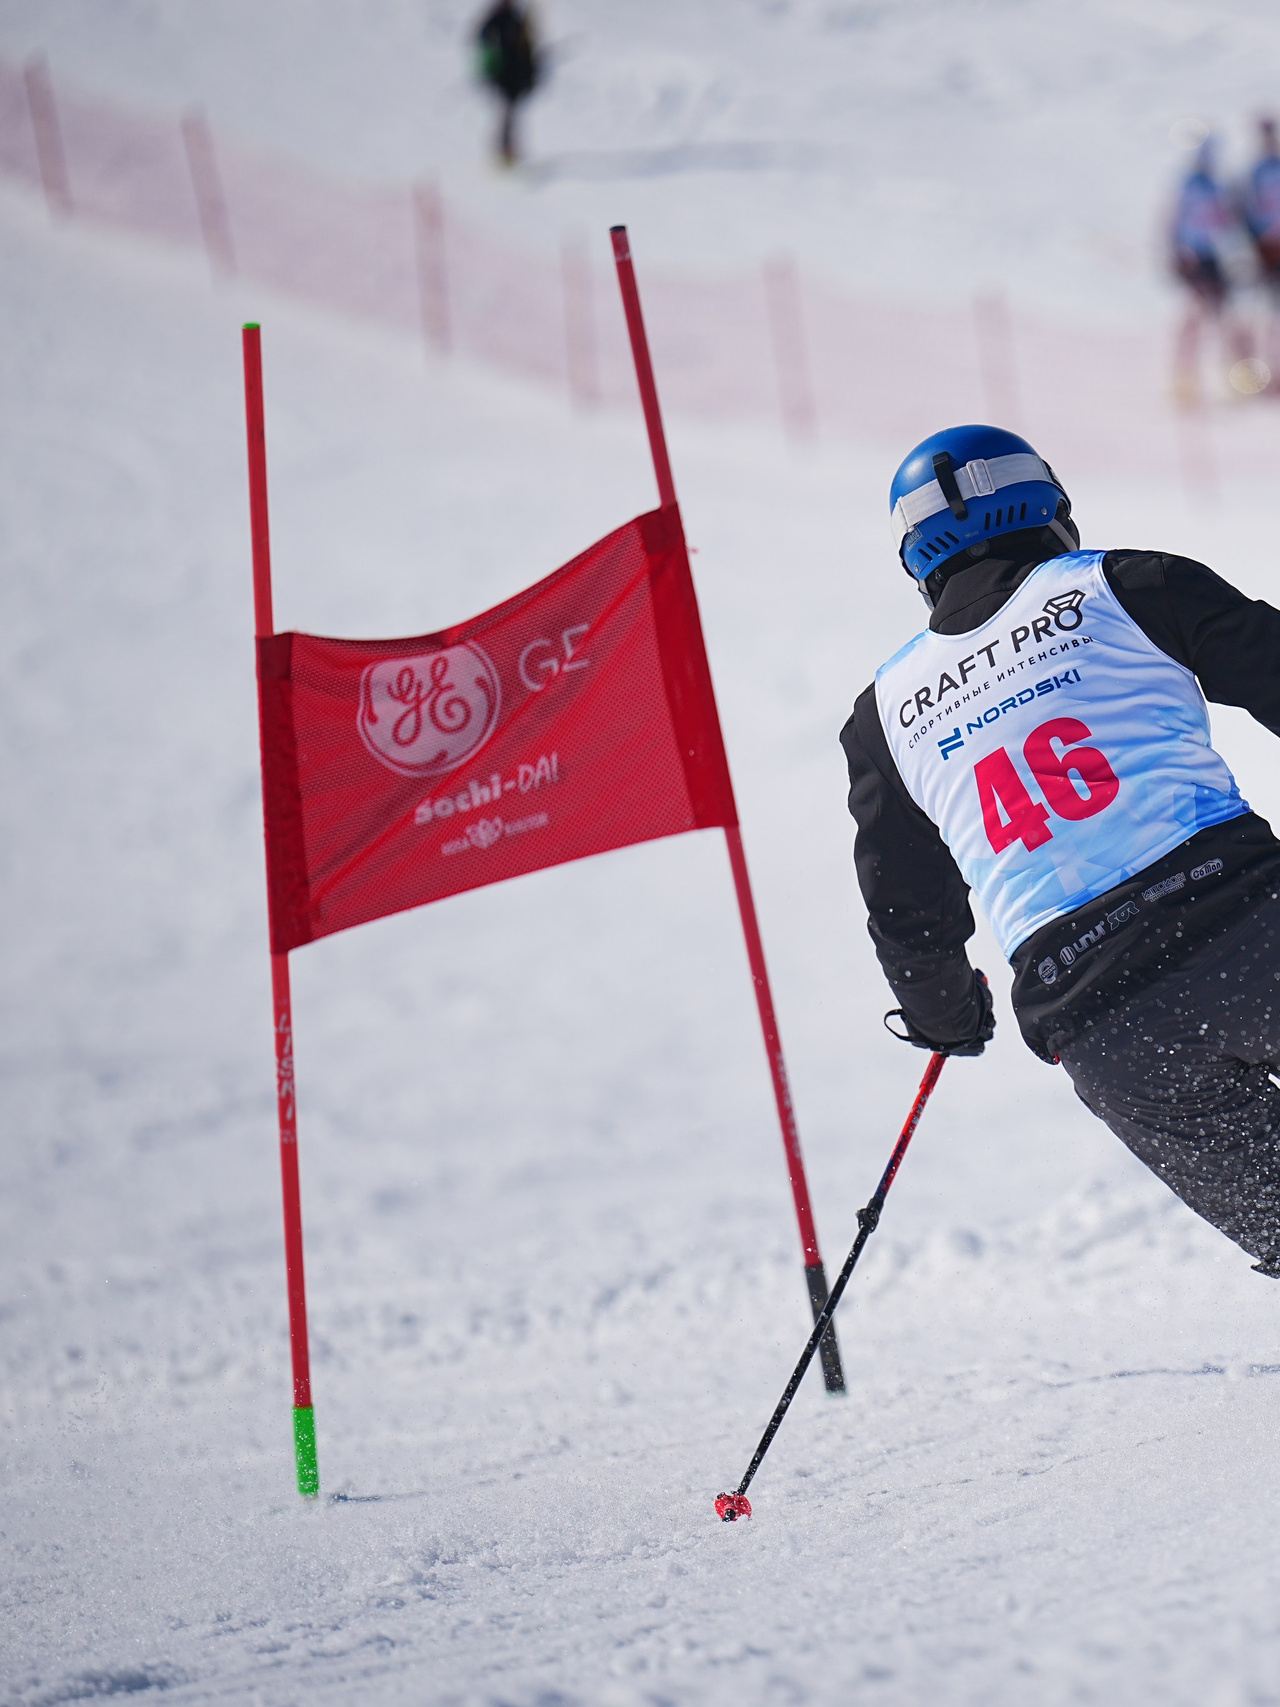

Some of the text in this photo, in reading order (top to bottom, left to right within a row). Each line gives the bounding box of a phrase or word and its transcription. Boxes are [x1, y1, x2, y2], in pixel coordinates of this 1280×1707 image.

[900, 600, 1084, 728] CRAFT PRO
[908, 636, 1094, 749] СПОРТИВНЫЕ ИНТЕНСИВЫ
[966, 668, 1082, 735] NORDSKI
[973, 717, 1120, 855] 46
